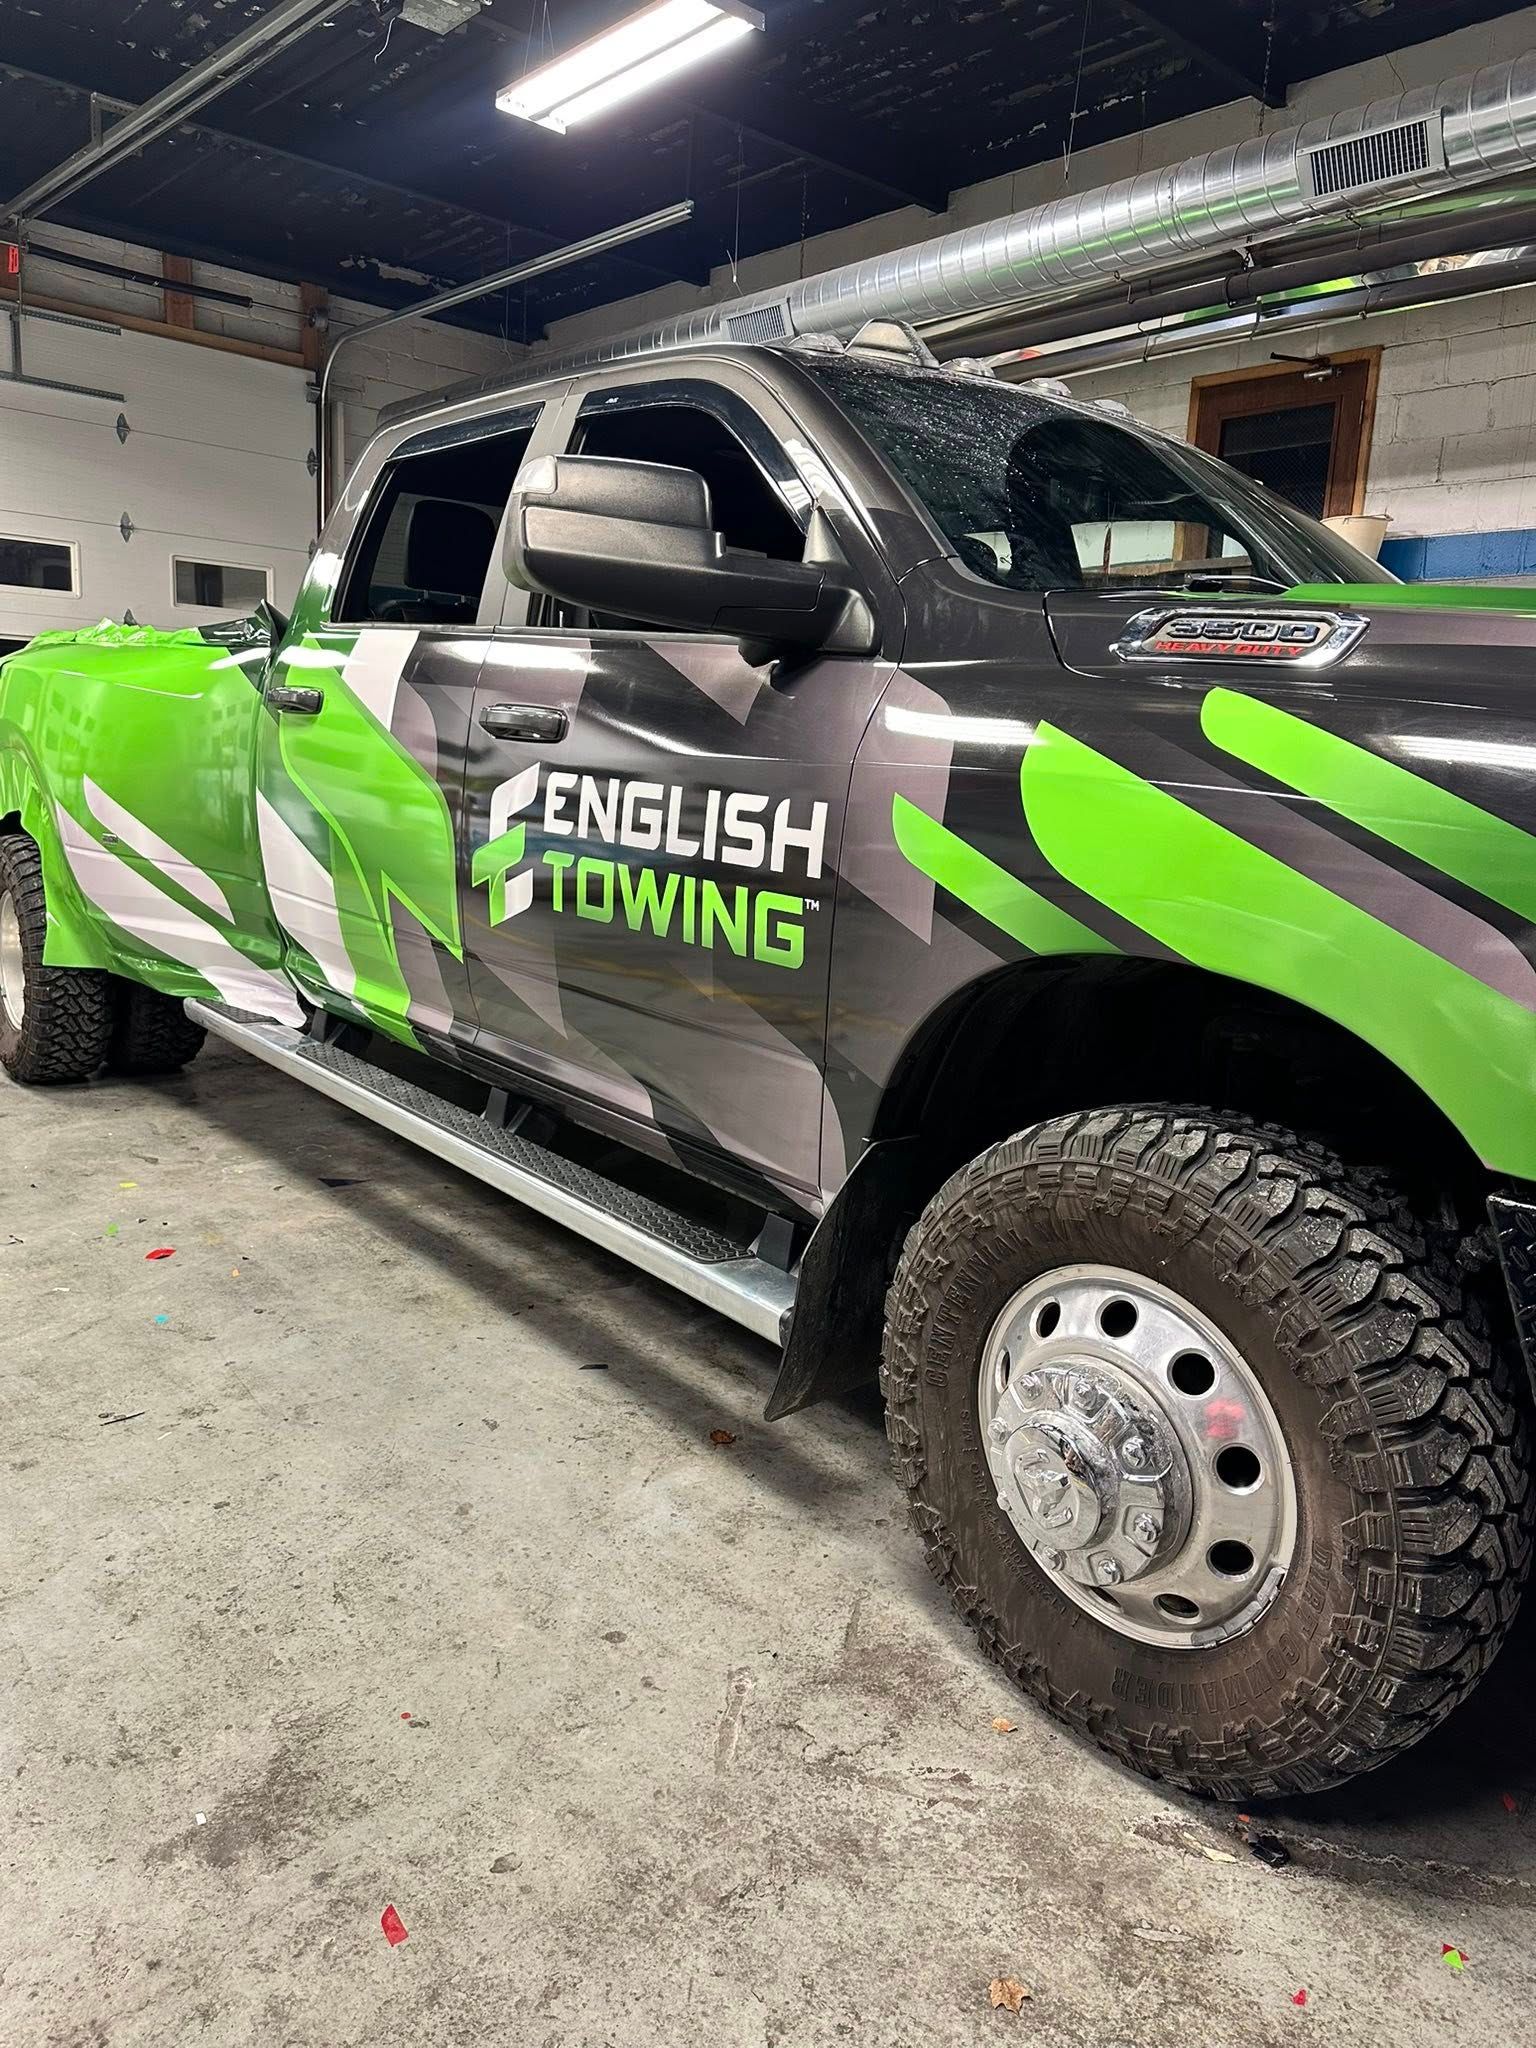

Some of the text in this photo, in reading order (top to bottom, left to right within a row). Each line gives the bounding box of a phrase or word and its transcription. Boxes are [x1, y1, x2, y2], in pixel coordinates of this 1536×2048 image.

[1155, 640, 1305, 657] HEAVY DUTY
[1166, 620, 1320, 642] 3500
[543, 771, 829, 880] ENGLISH
[542, 849, 805, 970] TOWING
[925, 1227, 1034, 1388] CENTENNIAL
[1111, 1540, 1333, 1715] DIRT COMMANDER
